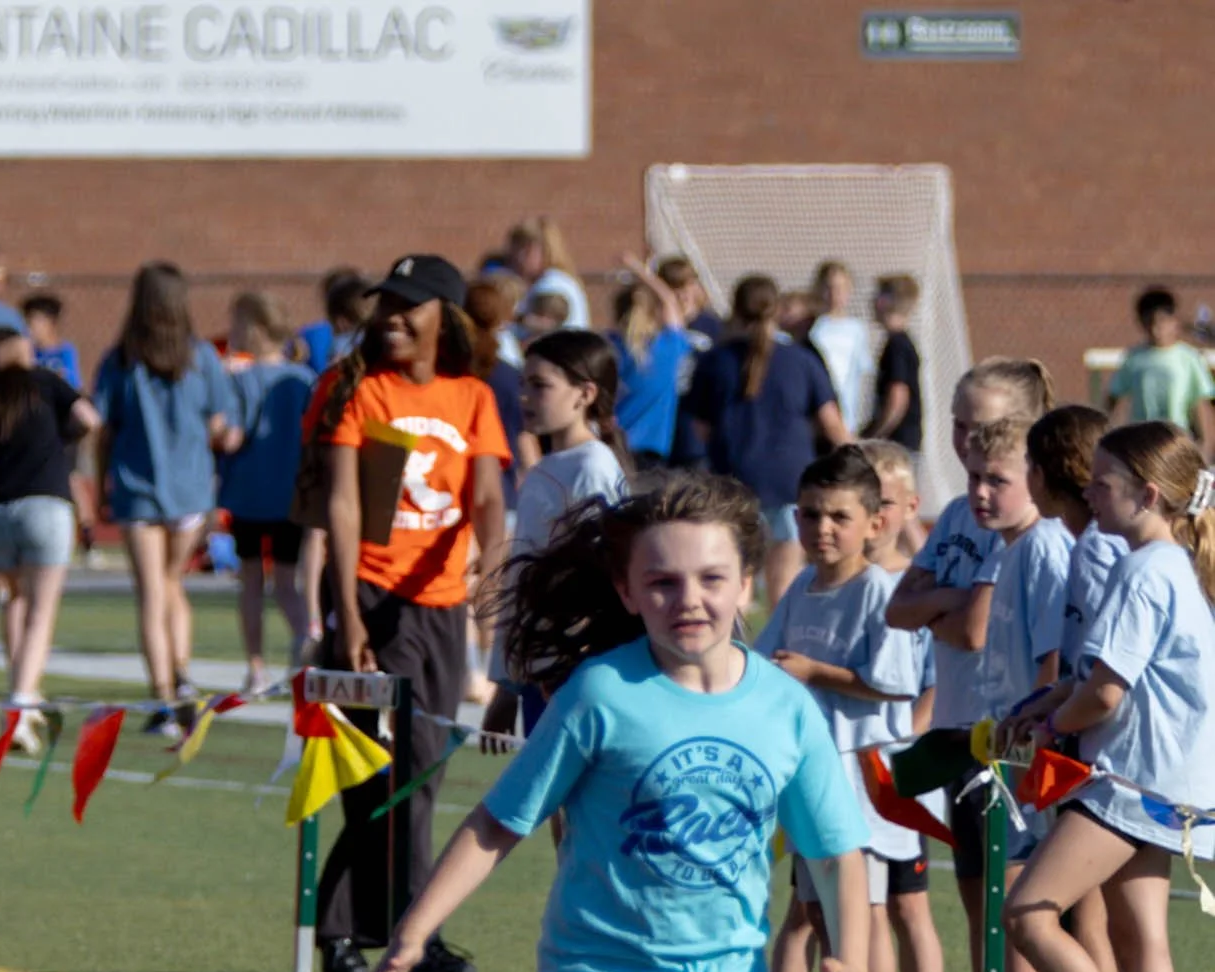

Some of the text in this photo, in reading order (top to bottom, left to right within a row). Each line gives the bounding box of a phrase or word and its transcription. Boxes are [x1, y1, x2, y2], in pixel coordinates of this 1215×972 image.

[183, 5, 456, 62] CADILLAC
[670, 745, 743, 773] IT'S A
